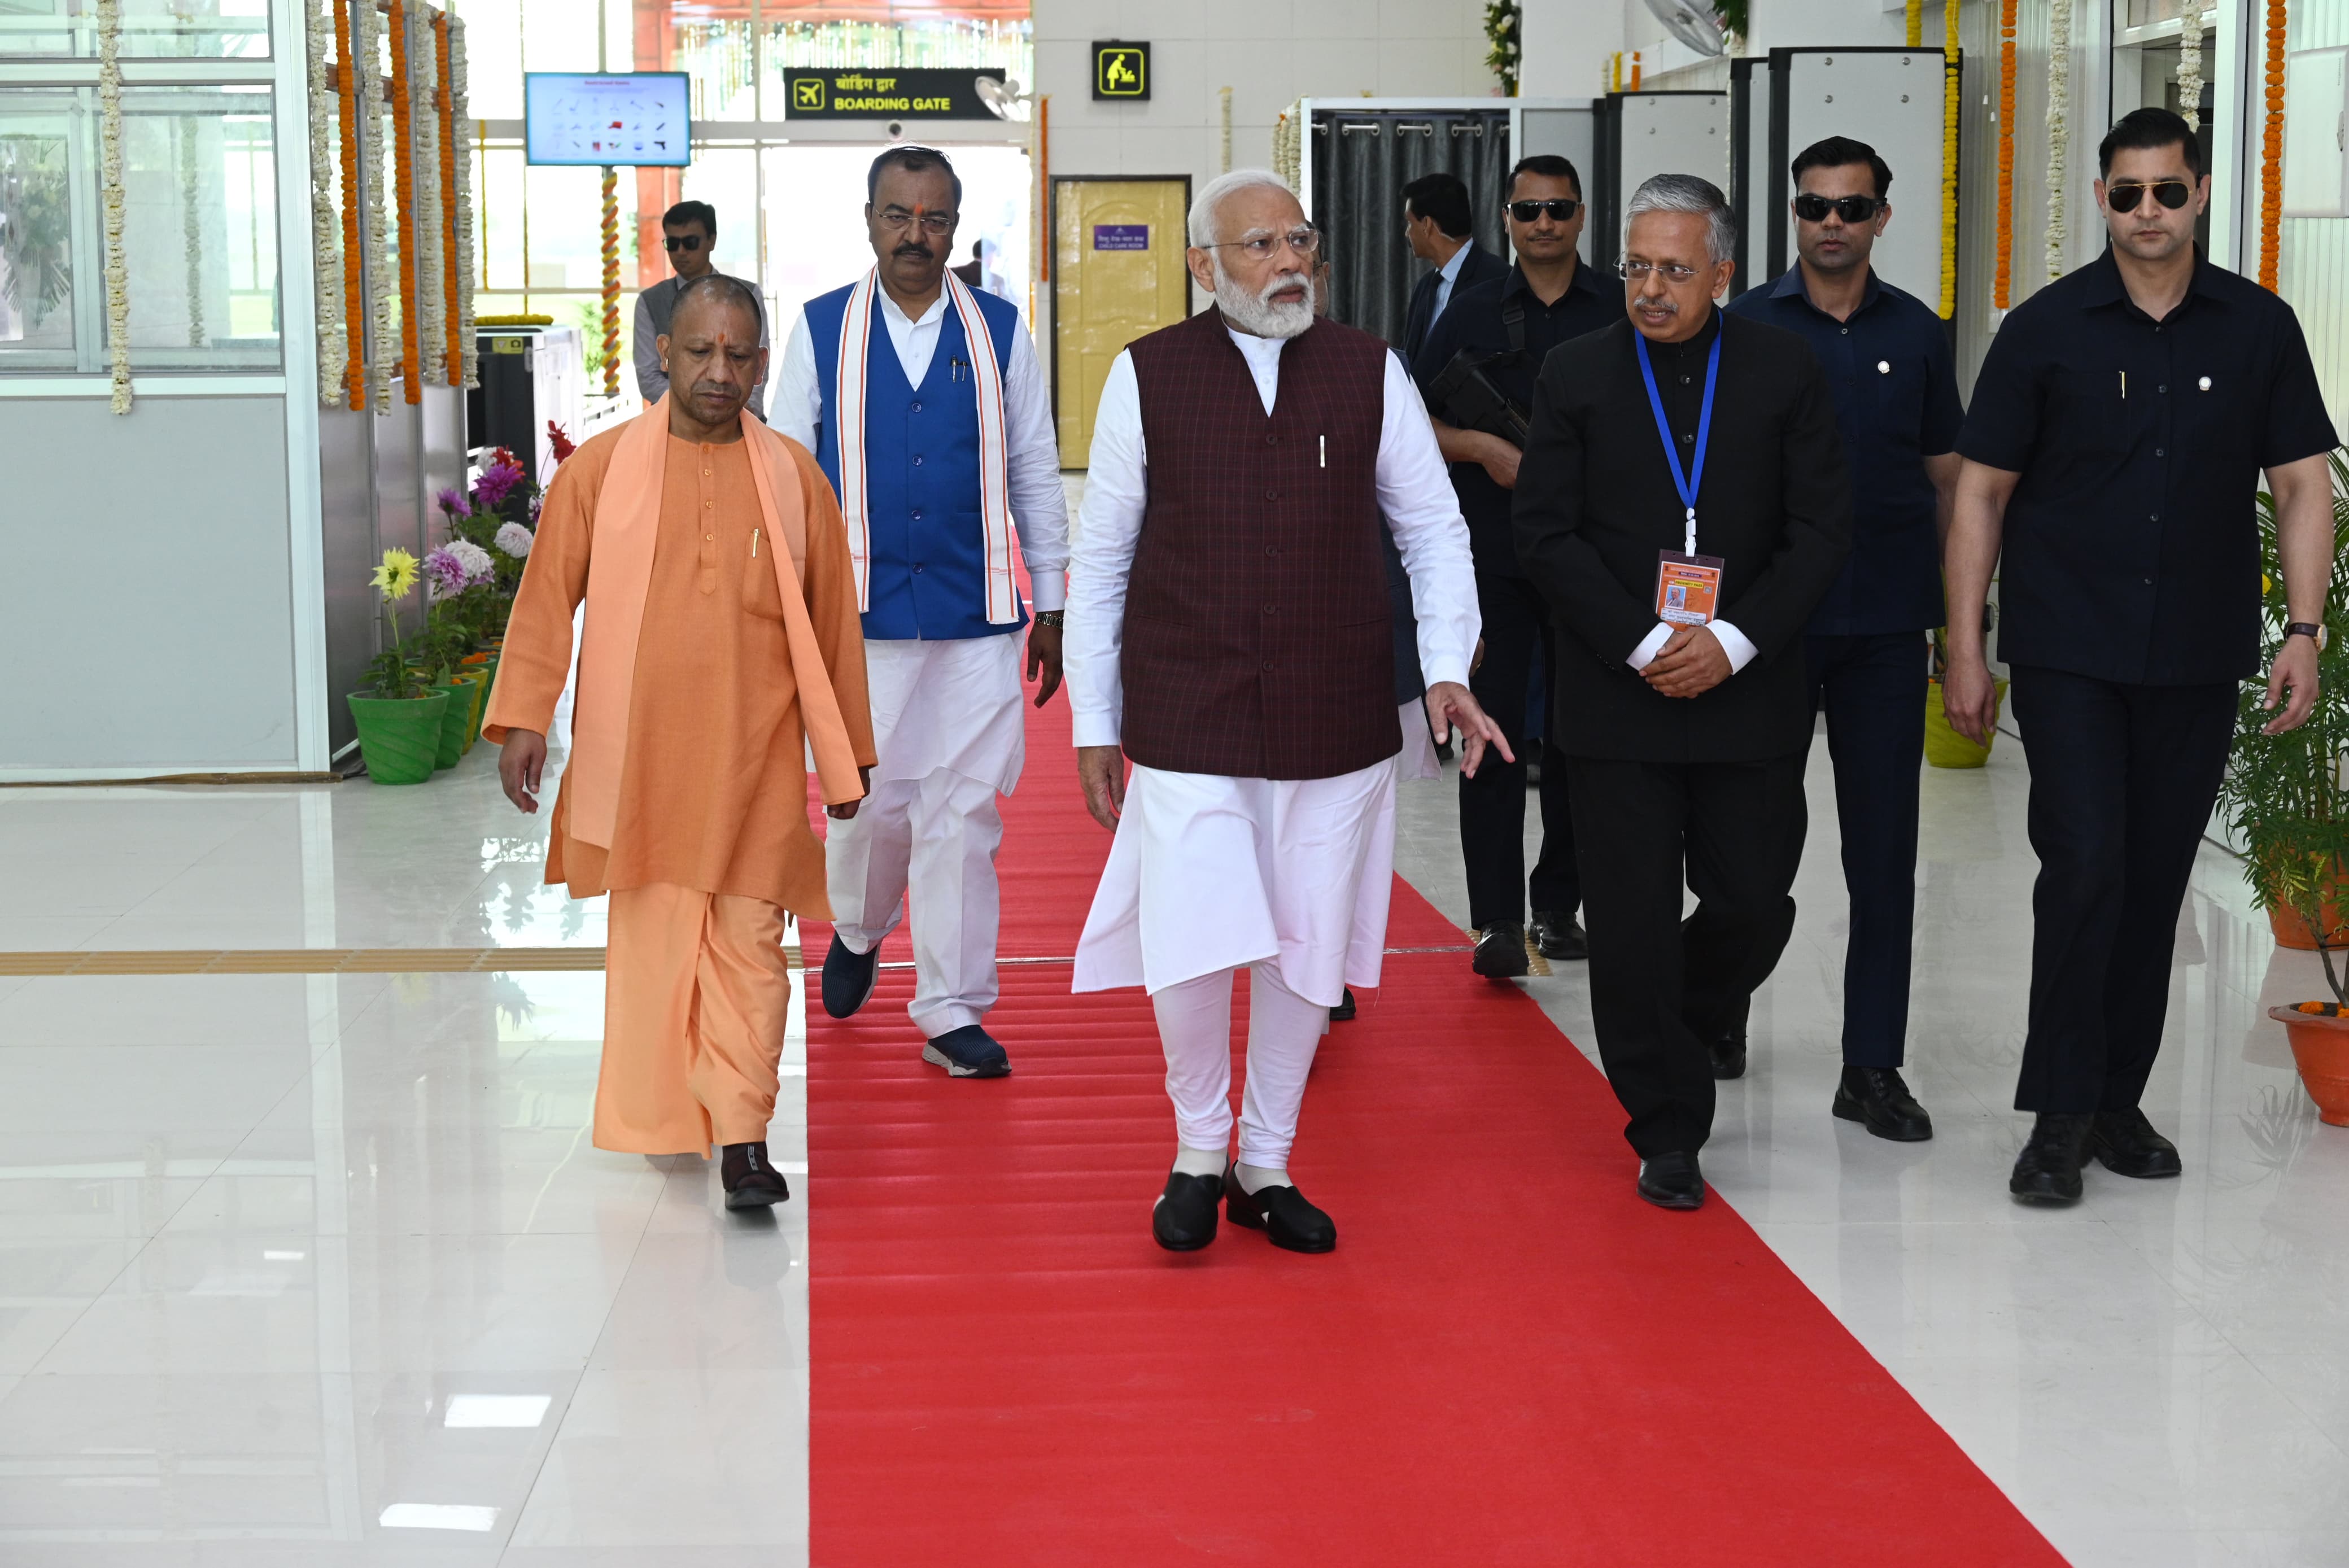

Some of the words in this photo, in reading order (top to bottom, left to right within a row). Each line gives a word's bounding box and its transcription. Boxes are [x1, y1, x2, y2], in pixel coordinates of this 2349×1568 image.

[875, 78, 897, 92] द्वार
[835, 98, 910, 110] BOARDING
[912, 98, 950, 110] GATE
